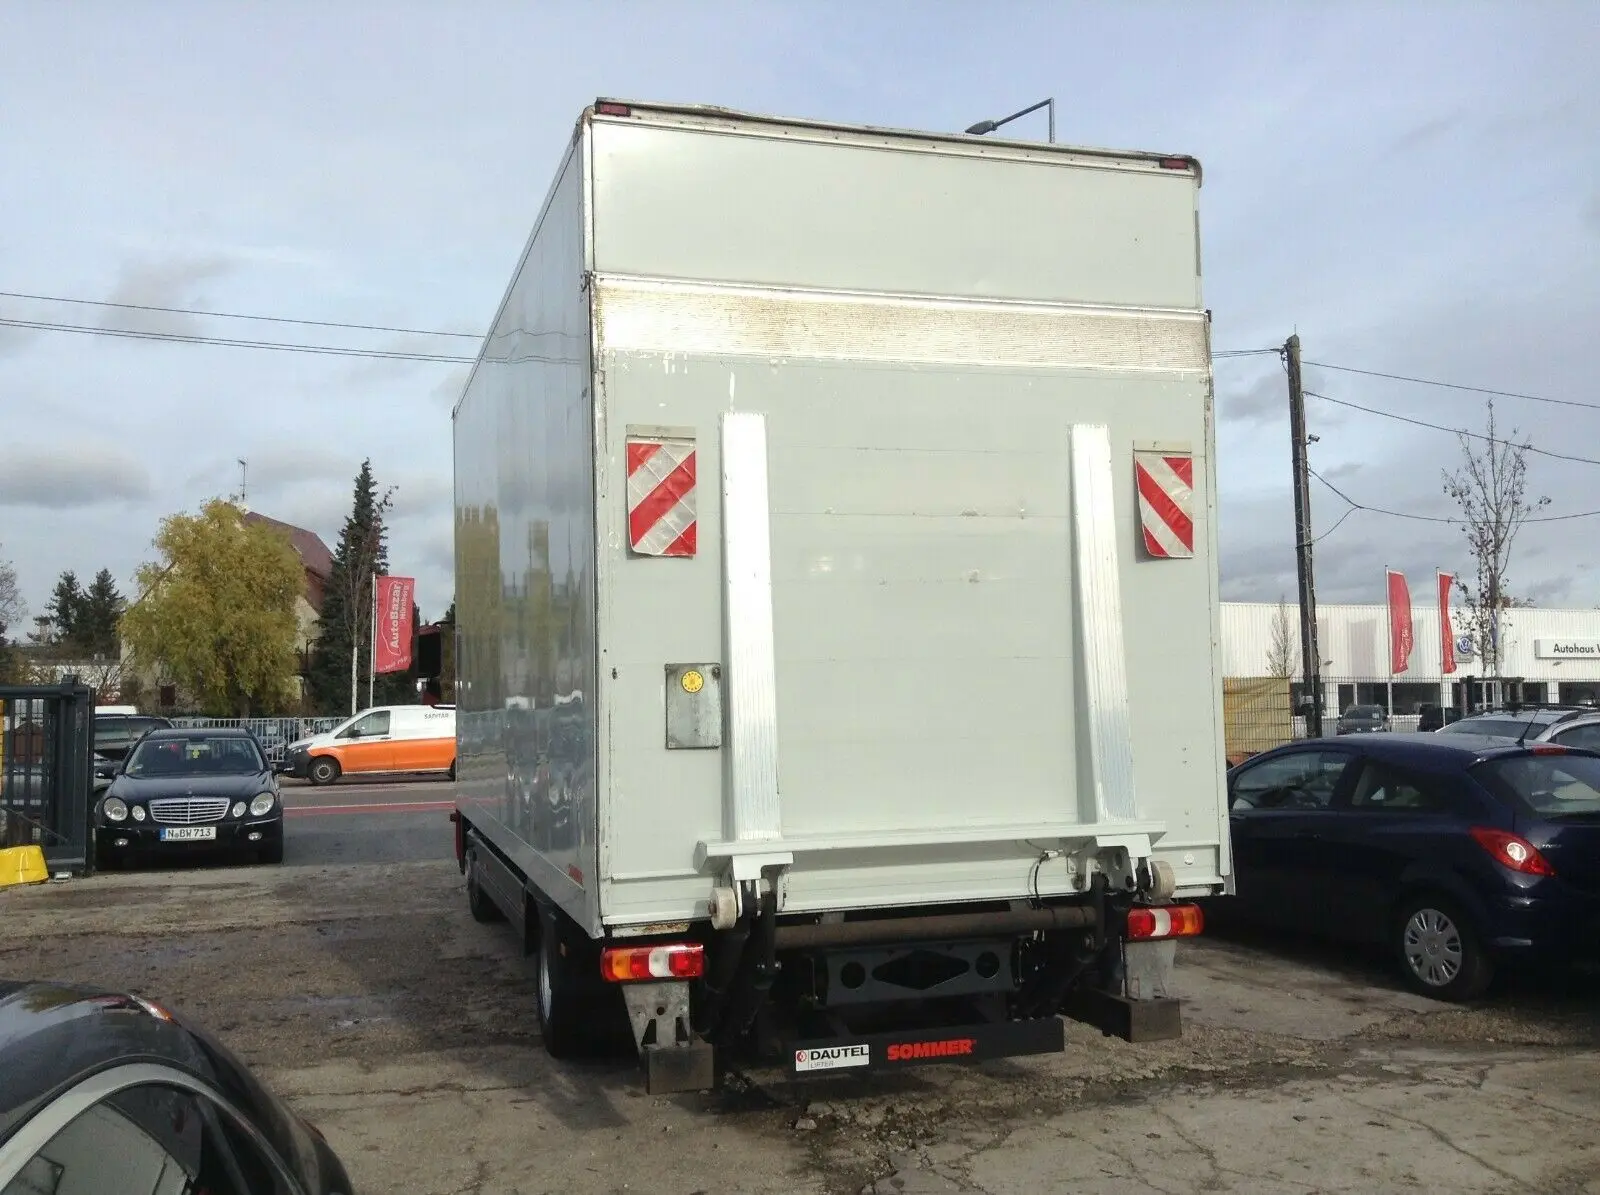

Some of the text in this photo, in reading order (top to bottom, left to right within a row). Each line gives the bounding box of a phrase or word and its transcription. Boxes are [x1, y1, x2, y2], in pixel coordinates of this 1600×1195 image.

[390, 584, 402, 648] AutoBazar
[1553, 643, 1594, 653] Autohaus
[810, 1046, 869, 1060] DAUTEL
[887, 1038, 974, 1060] SOMMER
[810, 1060, 834, 1068] LIFTER
